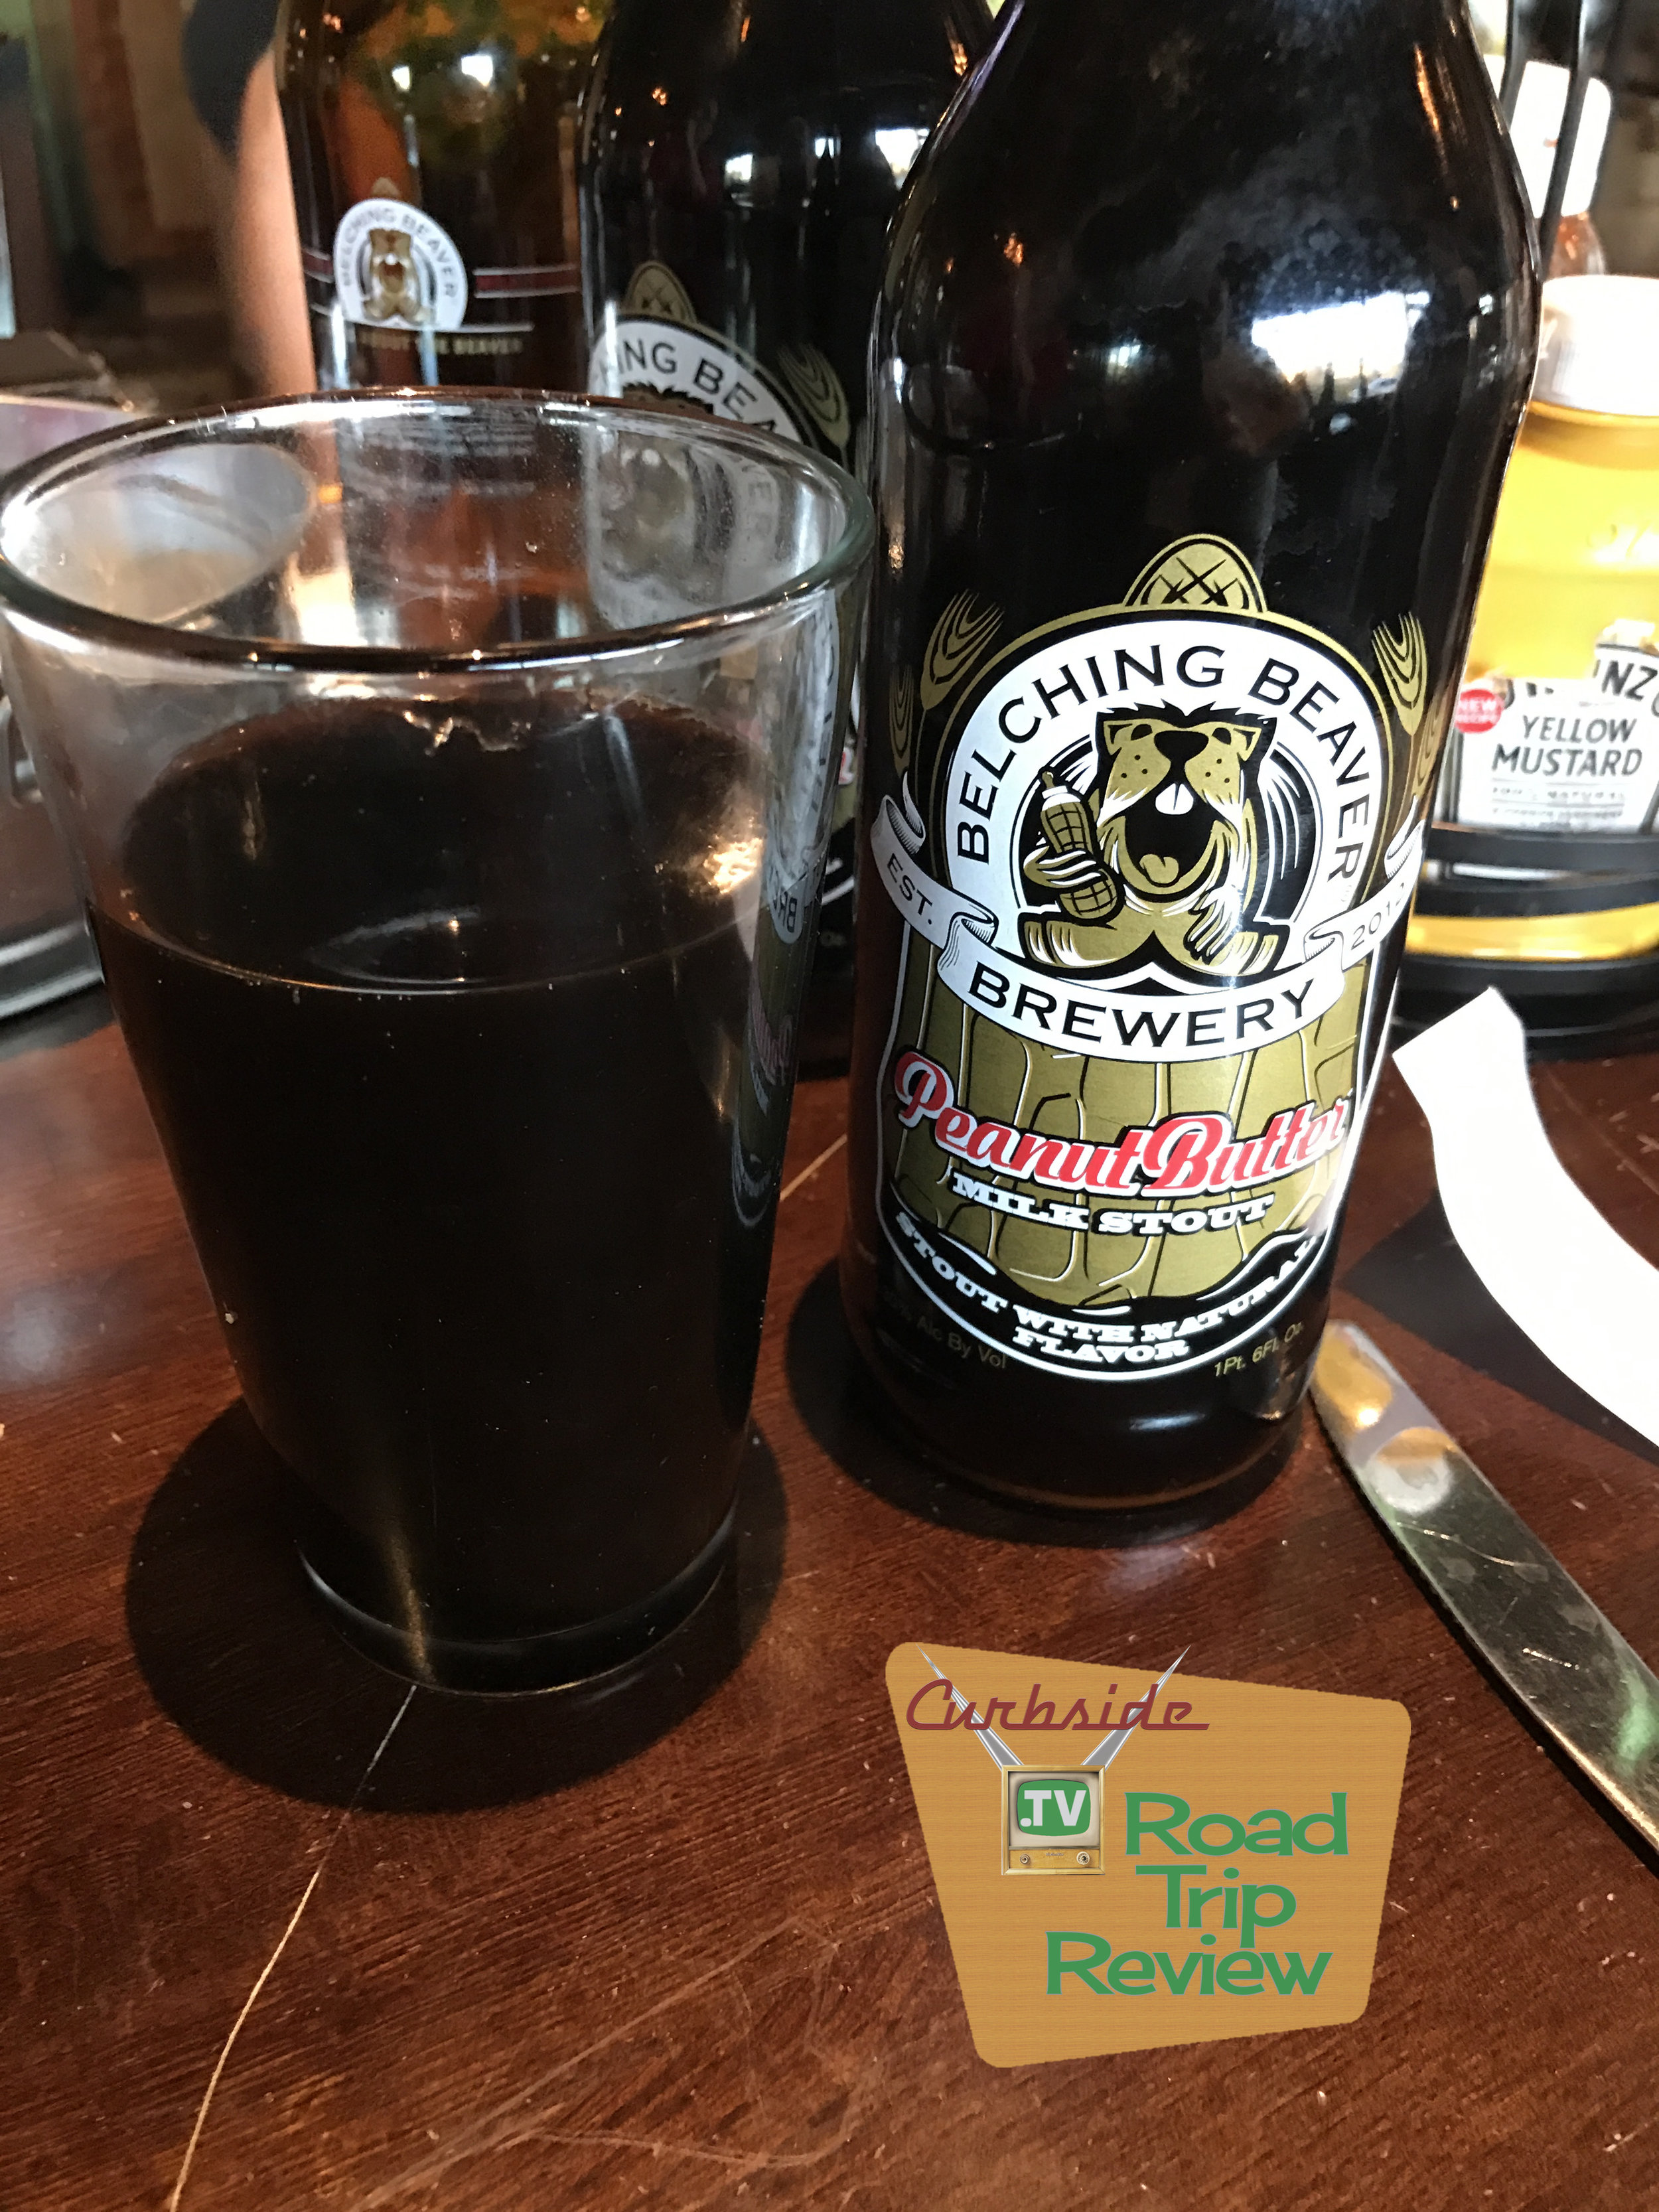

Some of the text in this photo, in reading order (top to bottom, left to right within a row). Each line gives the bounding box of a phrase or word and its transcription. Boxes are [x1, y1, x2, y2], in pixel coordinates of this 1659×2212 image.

[1492, 743, 1642, 776] MUSTARD
[1522, 715, 1637, 743] YELLOW
[958, 644, 1370, 883] BELCHING BEAVER
[887, 853, 933, 926] EST.
[968, 961, 1316, 1049] BREWERY
[895, 1051, 1349, 1196] Peanut Butter
[952, 1171, 1275, 1234] MILK STOUT
[896, 1212, 1317, 1343] STOUT WITH NATURAL
[948, 1331, 972, 1359] By
[977, 1345, 1007, 1369] Vol
[1012, 1326, 1190, 1363] FLAVOR
